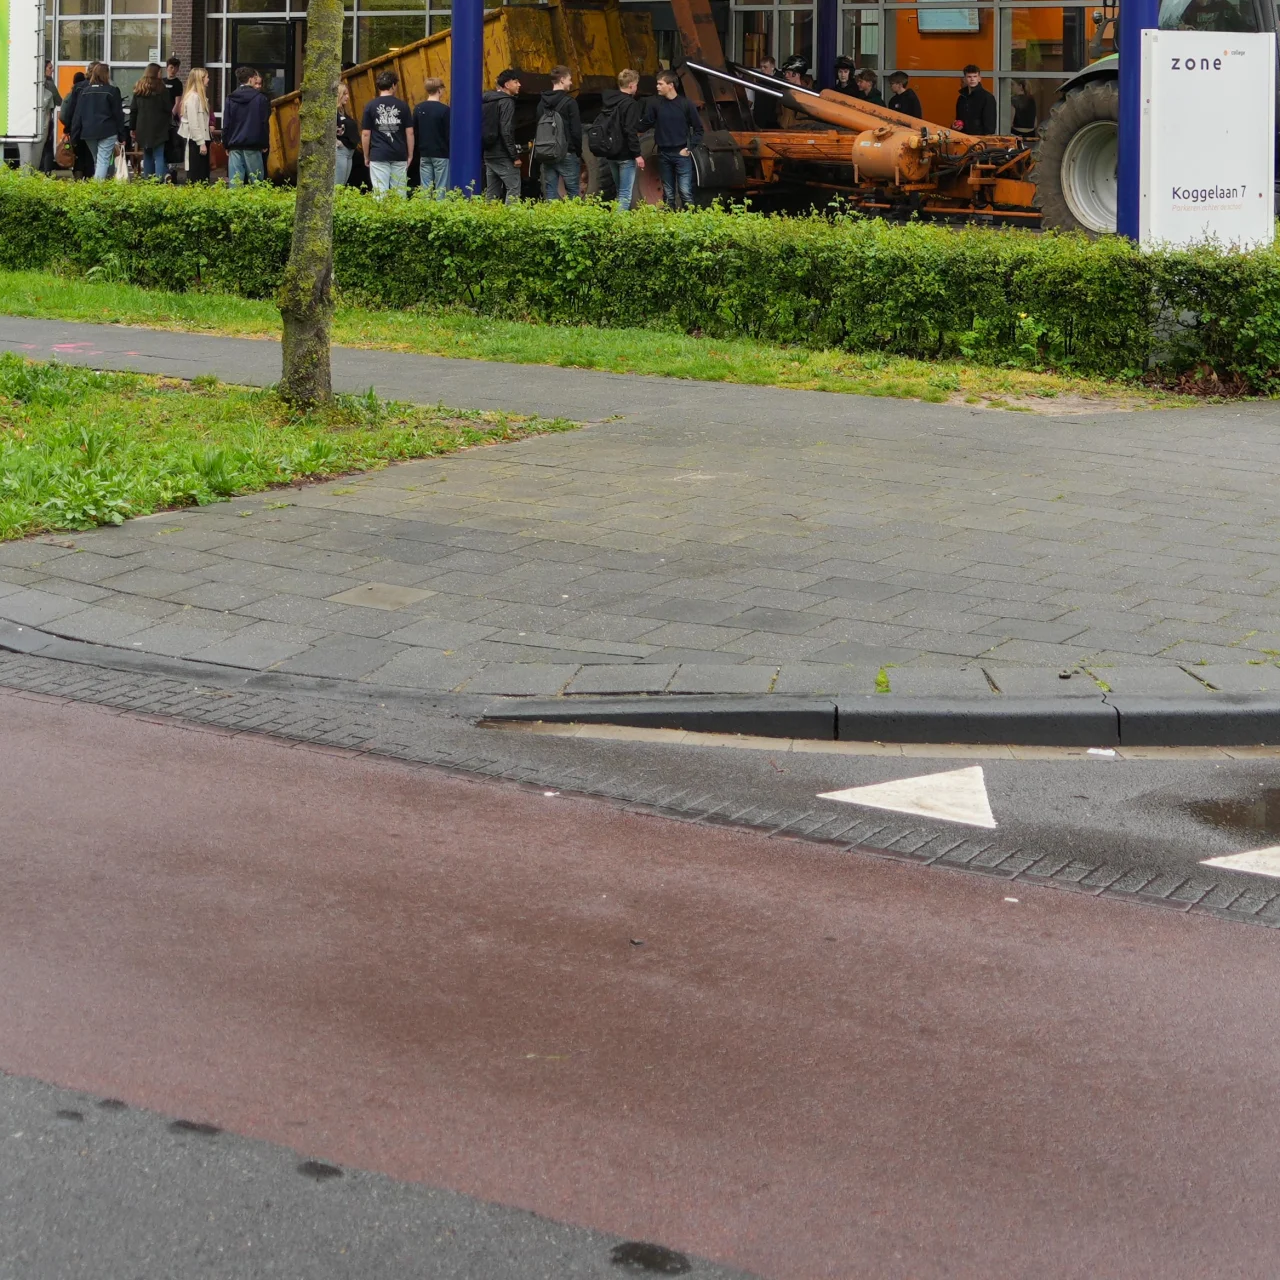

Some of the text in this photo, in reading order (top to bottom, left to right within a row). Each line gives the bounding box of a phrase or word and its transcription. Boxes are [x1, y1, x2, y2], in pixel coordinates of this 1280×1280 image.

[1171, 58, 1222, 71] zone
[1172, 185, 1247, 202] Koggelaan 7
